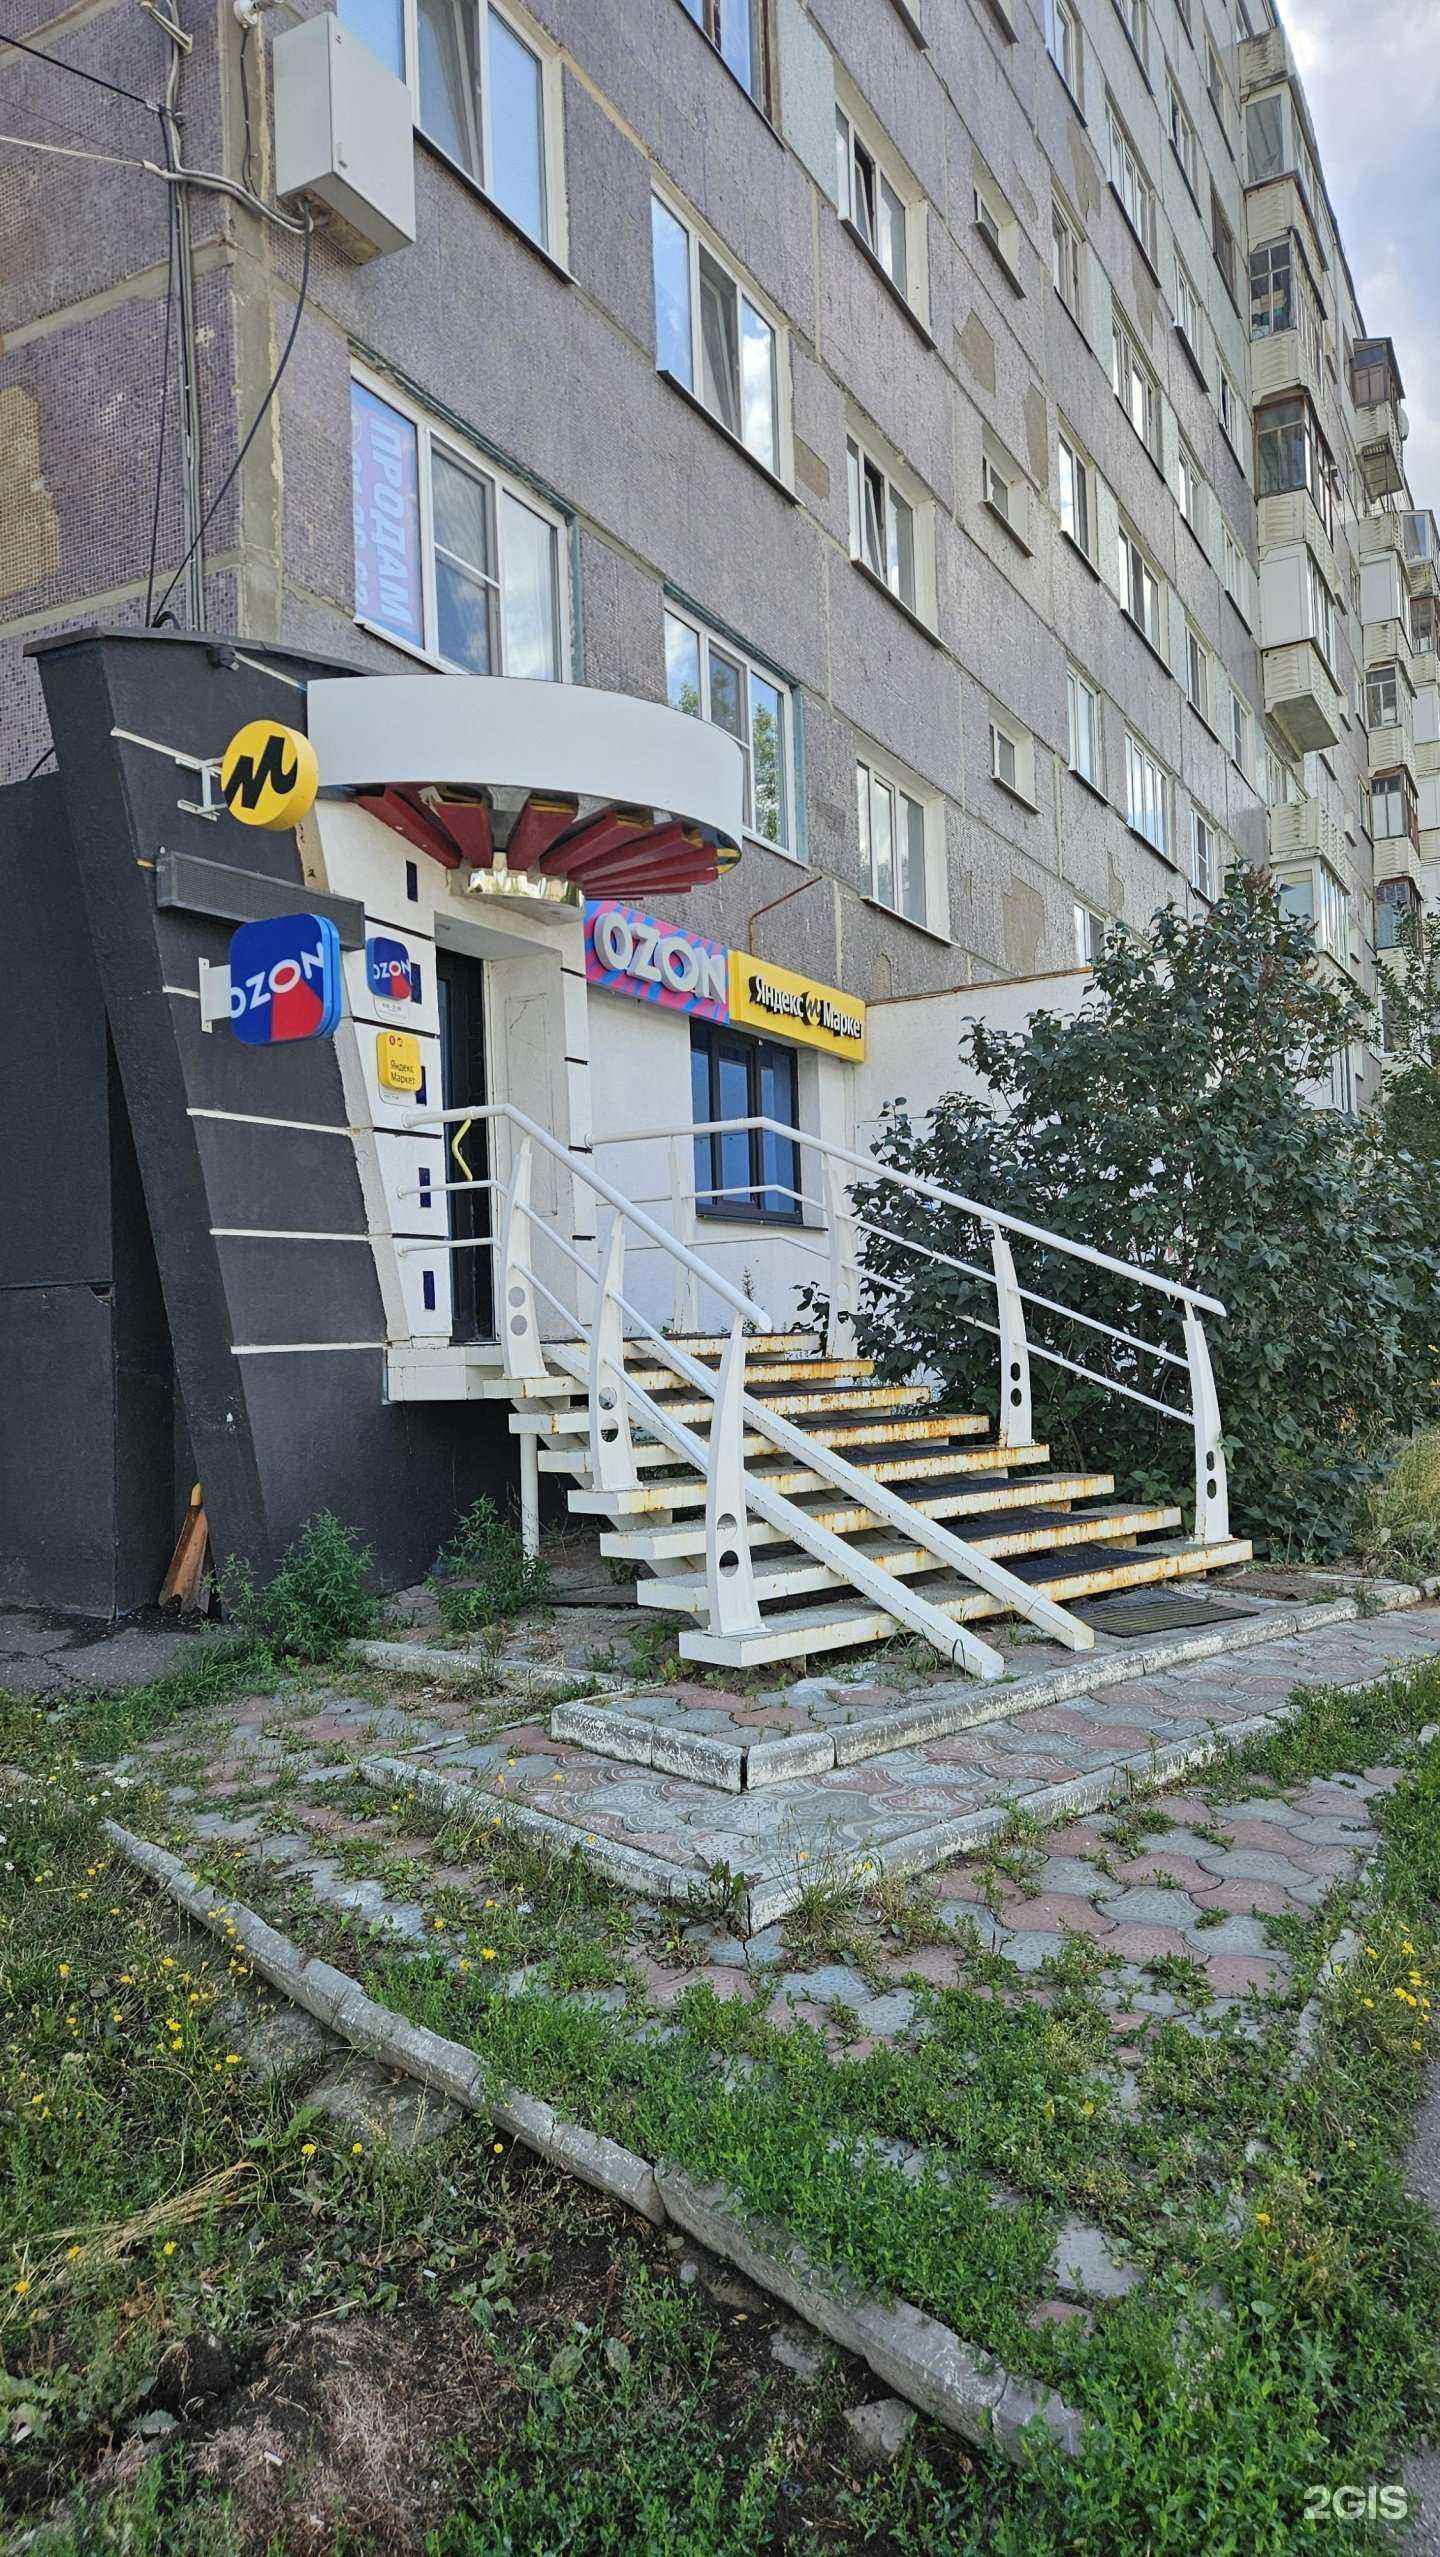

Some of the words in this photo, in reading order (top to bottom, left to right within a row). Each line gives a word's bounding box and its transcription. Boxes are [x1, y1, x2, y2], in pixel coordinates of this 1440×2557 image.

[369, 414, 414, 624] ПРОДАМ
[229, 941, 324, 1019] OZON
[594, 911, 726, 1004] OZON
[751, 976, 804, 1018] Яндекс
[390, 1071, 416, 1085] Маркет
